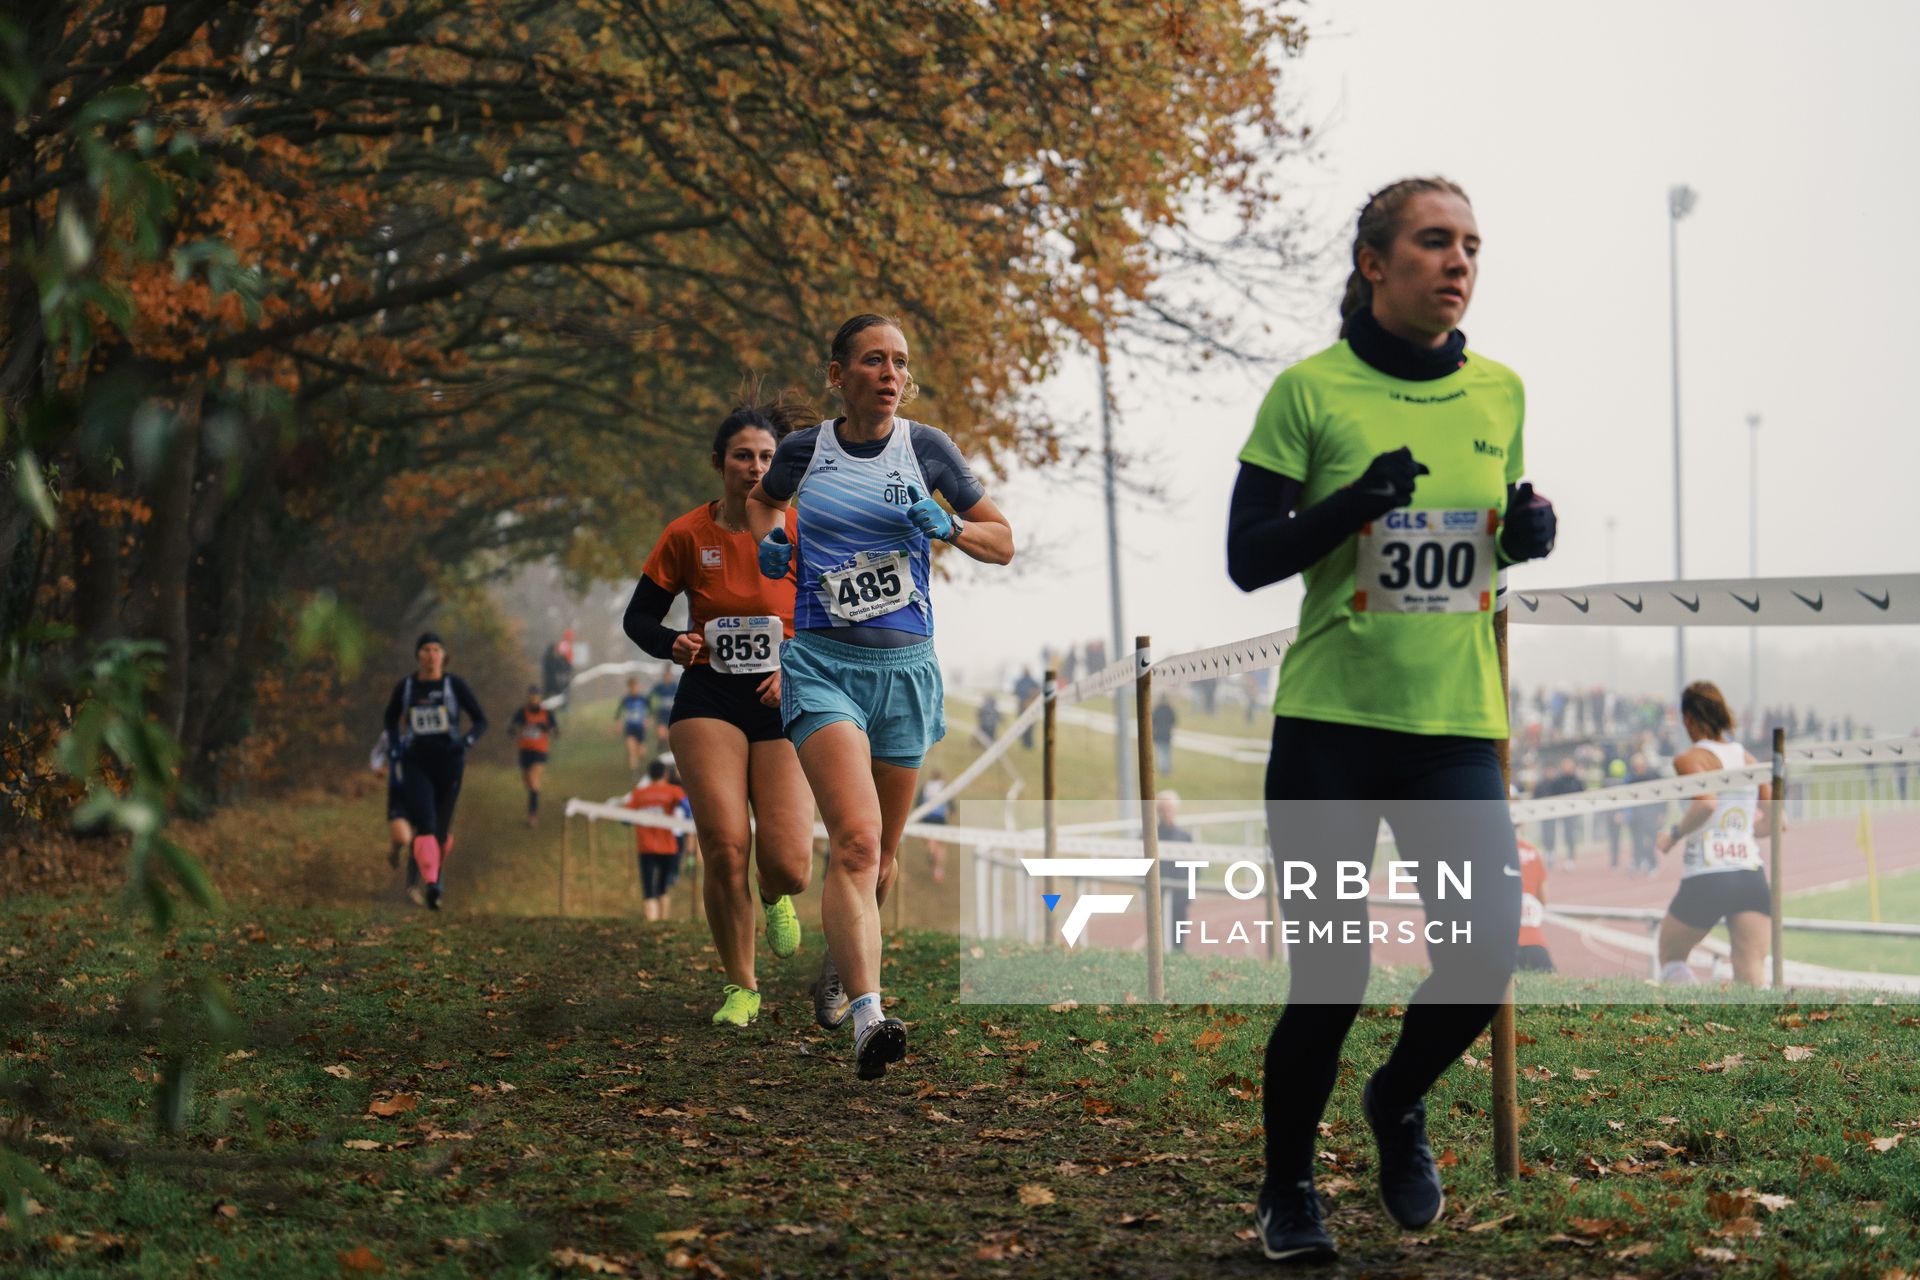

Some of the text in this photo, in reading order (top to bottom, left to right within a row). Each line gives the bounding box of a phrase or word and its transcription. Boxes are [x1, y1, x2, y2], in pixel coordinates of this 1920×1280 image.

[884, 484, 908, 505] OTB
[1386, 511, 1428, 529] GLS
[1379, 541, 1476, 590] 300
[838, 564, 901, 607] 485
[717, 618, 740, 628] GLS
[716, 633, 771, 661] 853
[1713, 841, 1748, 859] 948
